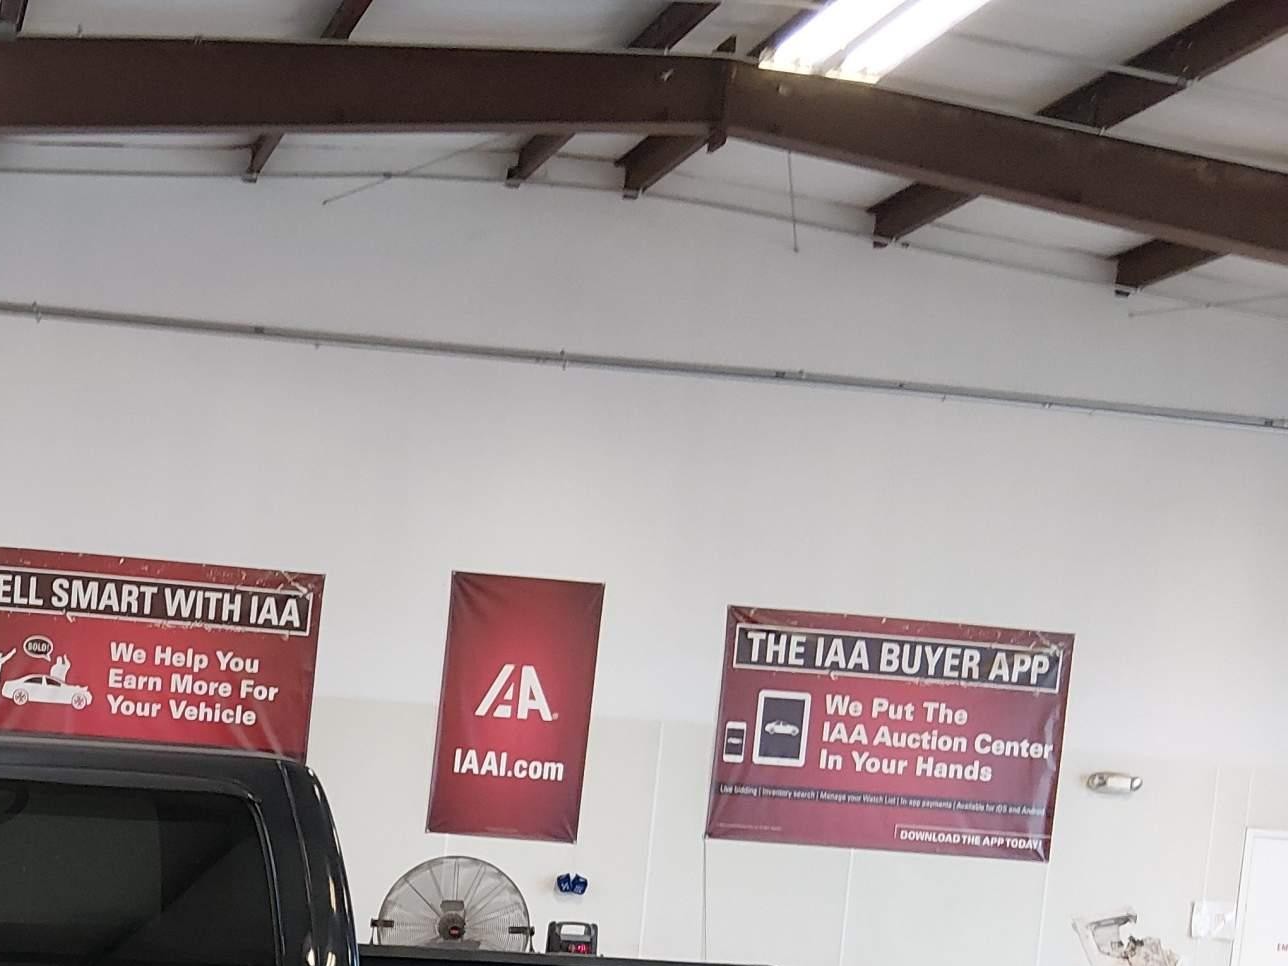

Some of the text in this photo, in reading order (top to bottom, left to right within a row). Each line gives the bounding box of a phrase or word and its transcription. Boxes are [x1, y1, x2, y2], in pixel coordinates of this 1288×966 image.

[51, 577, 158, 615] SMART
[164, 587, 242, 622] WITH
[249, 595, 300, 627] IAA
[110, 641, 259, 673] We Help You
[747, 631, 1050, 685] THE IAA BUYER APP
[108, 668, 279, 701] Earn More For
[107, 694, 257, 726] Your Vehicle
[825, 693, 968, 725] We Put The
[822, 721, 1054, 760] IAA Auction Center
[453, 748, 564, 781] IAAI.com
[819, 748, 993, 782] In Your Hands
[900, 831, 1042, 850] DOWNLOAD THE APP TODAY!
